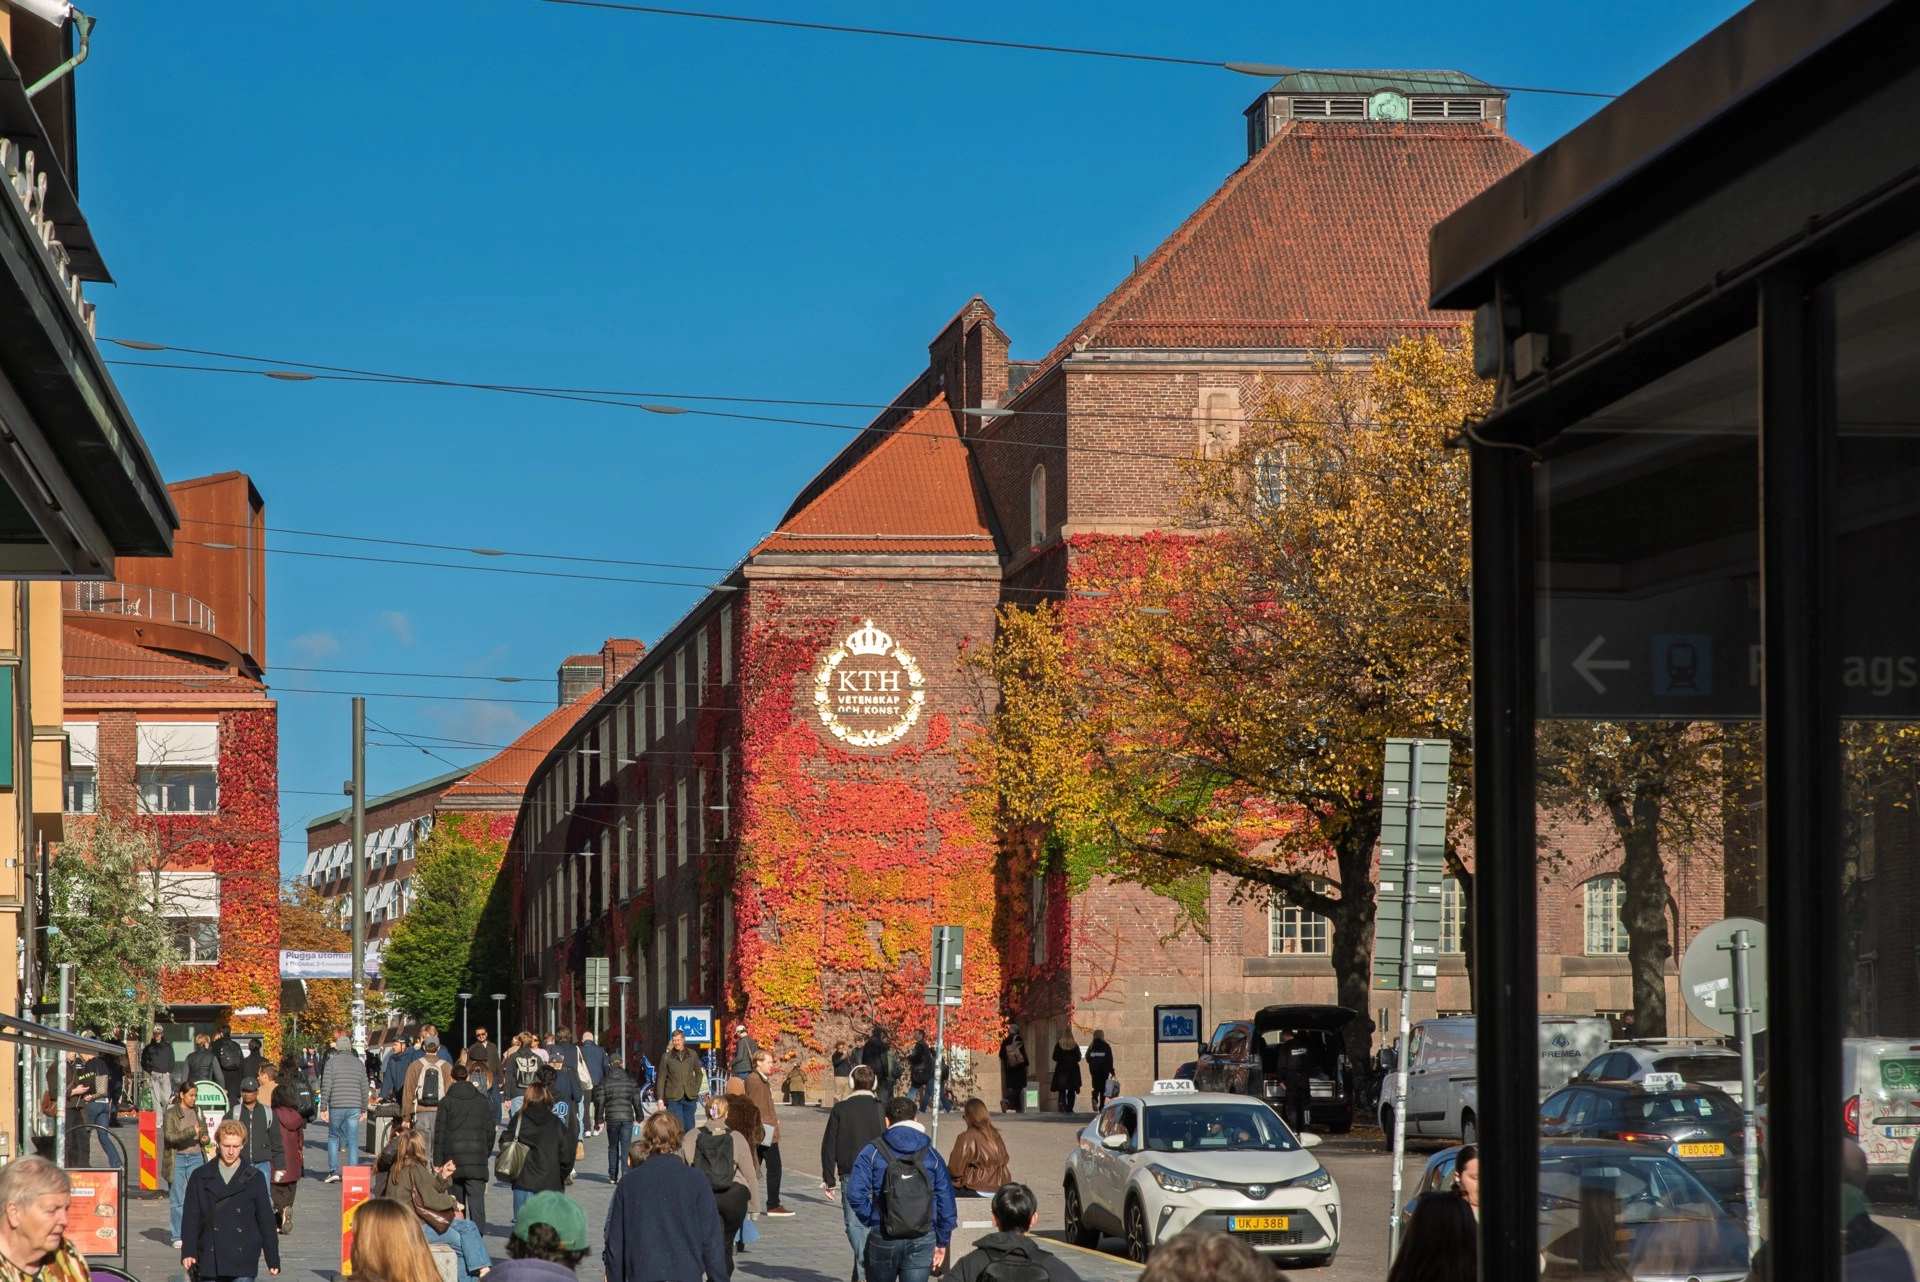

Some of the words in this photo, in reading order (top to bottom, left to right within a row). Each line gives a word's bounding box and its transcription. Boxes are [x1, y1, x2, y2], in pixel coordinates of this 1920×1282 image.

[837, 670, 901, 692] KTH
[837, 695, 900, 705] VETENSKAP
[837, 705, 860, 714] OCH
[864, 706, 900, 715] KONST
[285, 951, 317, 961] Plugga
[1541, 1050, 1581, 1058] PREMEA
[1649, 1074, 1679, 1082] TAXI
[1157, 1080, 1191, 1090] TAXI
[1681, 1145, 1698, 1154] TBD
[1702, 1144, 1720, 1153] 02P
[1238, 1218, 1260, 1229] UKJ
[1263, 1218, 1284, 1229] 38B
